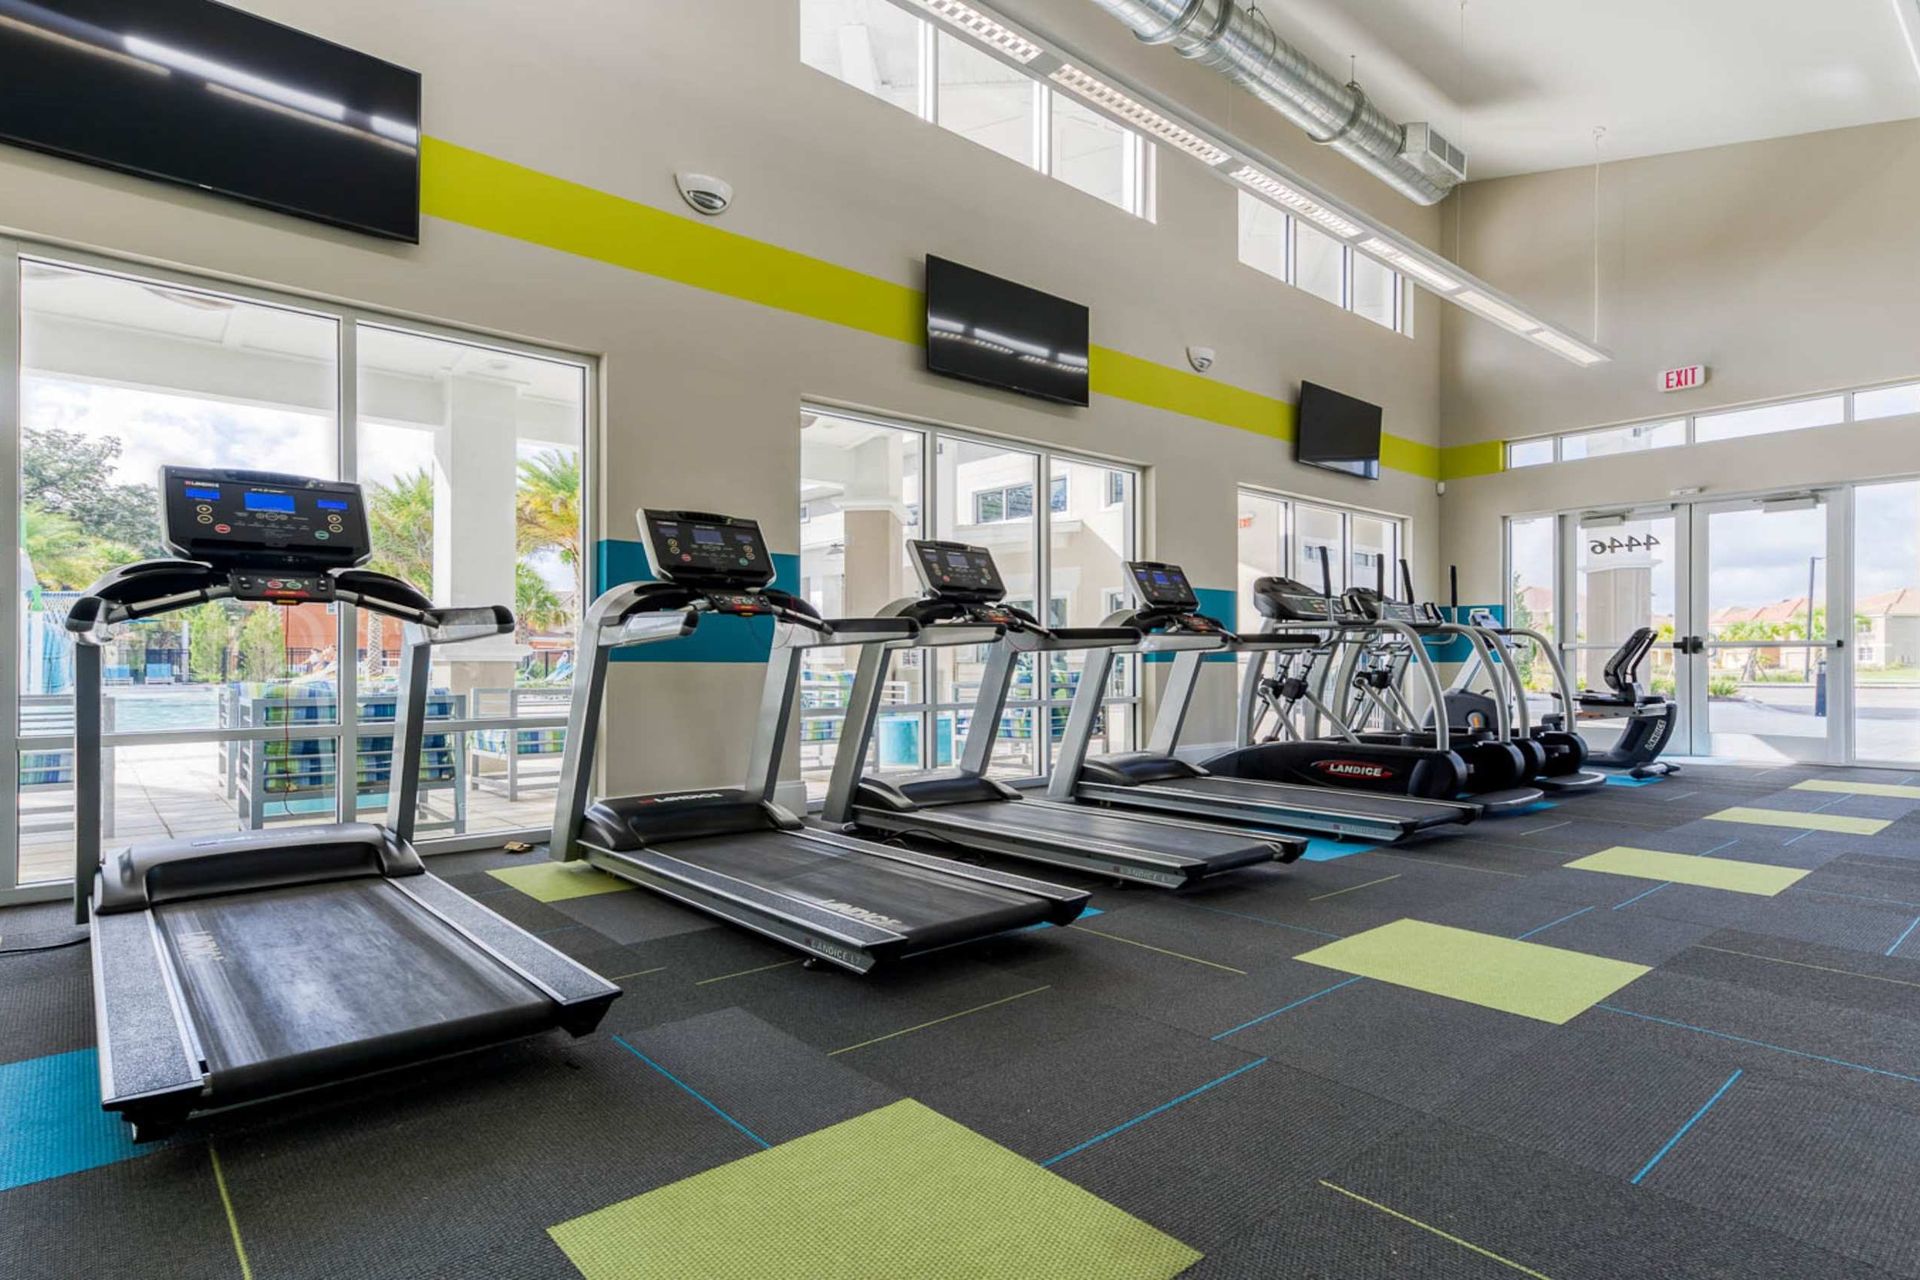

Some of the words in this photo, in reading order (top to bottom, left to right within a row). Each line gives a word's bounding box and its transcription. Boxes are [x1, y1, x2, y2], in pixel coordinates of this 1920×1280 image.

[1665, 367, 1697, 389] EXIT
[1329, 763, 1383, 777] LANDICE
[811, 939, 849, 960] LANDICE
